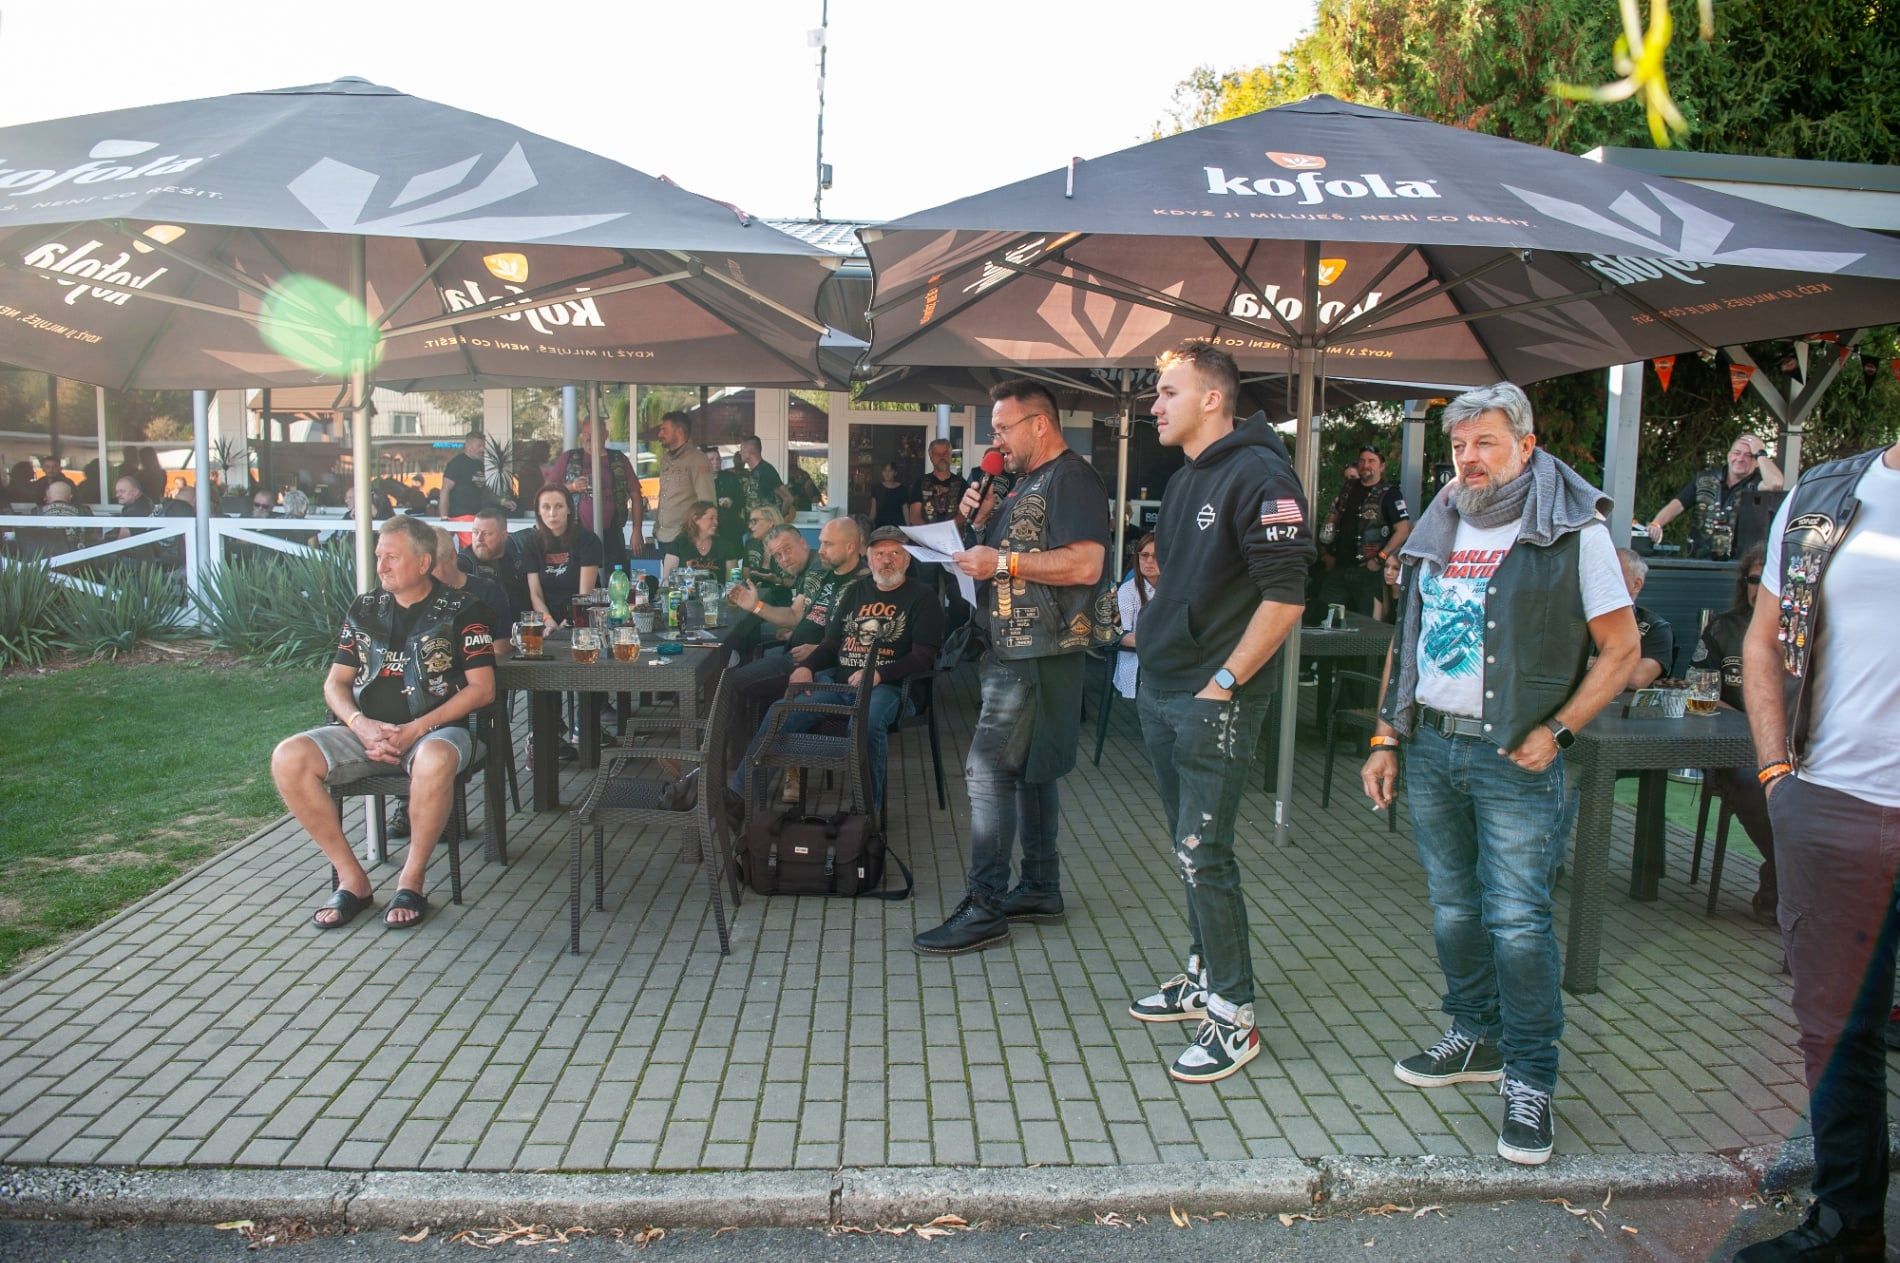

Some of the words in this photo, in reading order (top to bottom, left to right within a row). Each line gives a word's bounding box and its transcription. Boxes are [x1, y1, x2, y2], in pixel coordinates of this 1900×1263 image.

[1203, 167, 1442, 205] kofola
[103, 191, 137, 201] CO
[1153, 207, 1216, 217] KDYŽ
[1223, 211, 1240, 219] JI
[1360, 213, 1419, 222] NENÍ
[858, 602, 897, 617] HOG
